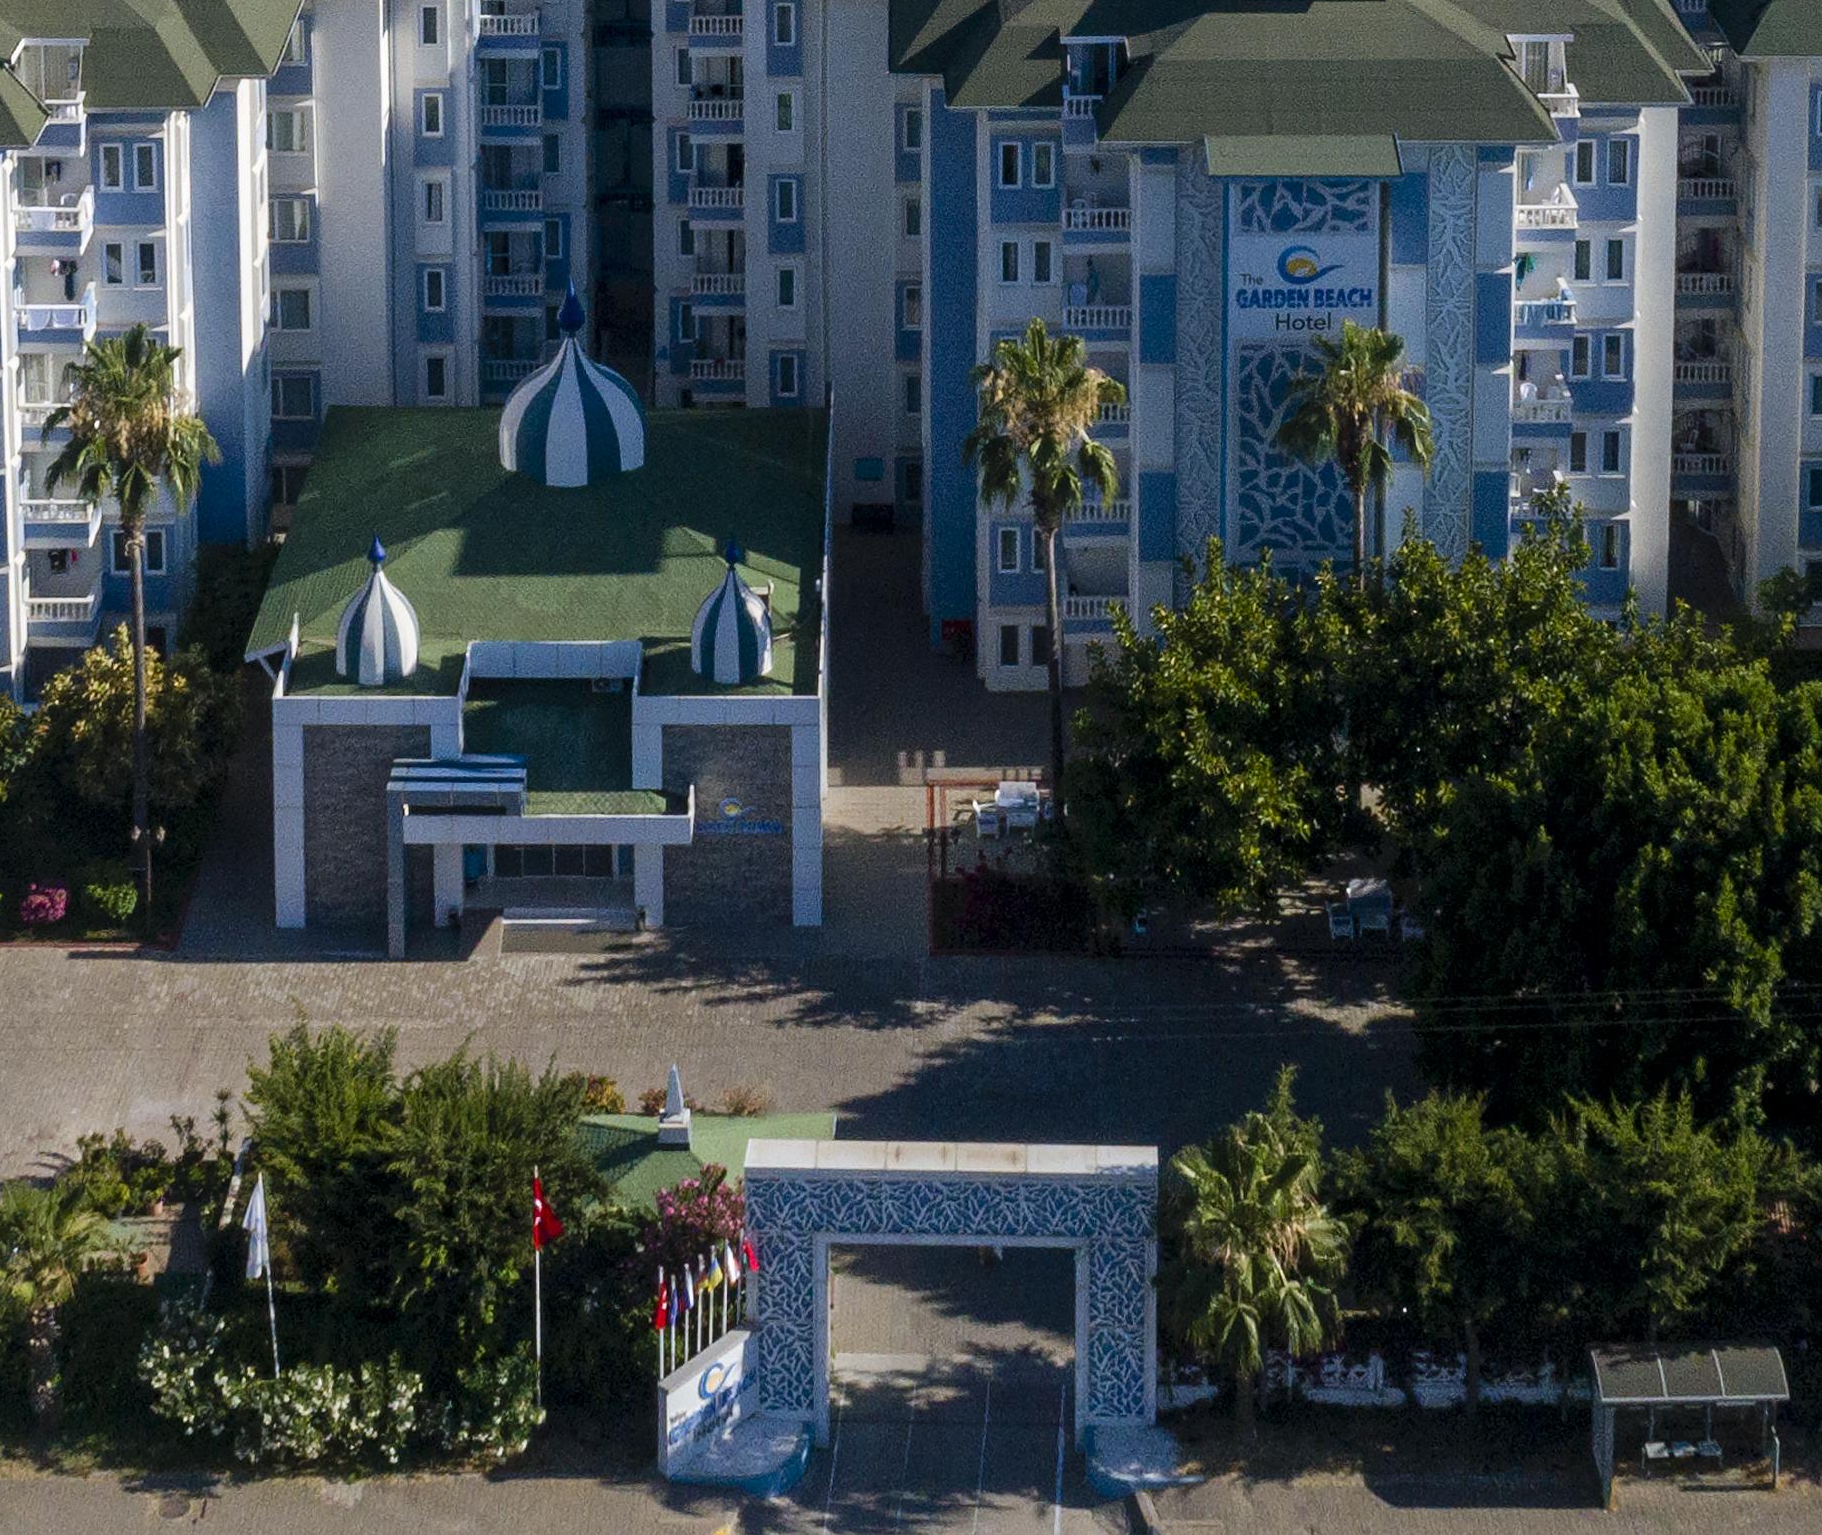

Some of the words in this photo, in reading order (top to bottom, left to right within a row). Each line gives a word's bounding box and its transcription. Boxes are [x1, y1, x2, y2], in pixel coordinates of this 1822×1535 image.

[1240, 274, 1264, 286] The
[1236, 288, 1310, 309] GARDEN
[1313, 288, 1373, 308] BEACH
[1275, 312, 1331, 331] Hotel
